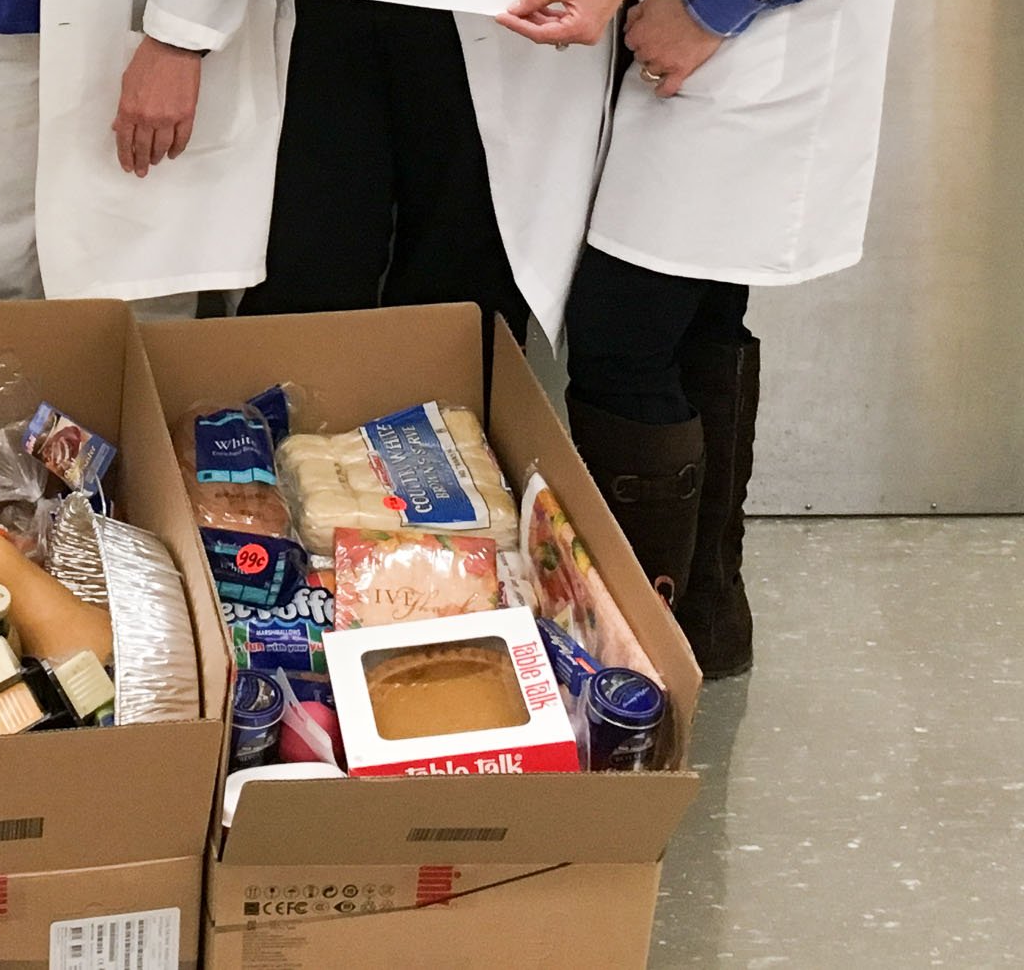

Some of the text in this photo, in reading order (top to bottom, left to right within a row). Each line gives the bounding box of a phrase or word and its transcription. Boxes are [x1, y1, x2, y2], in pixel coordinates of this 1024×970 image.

[266, 641, 288, 652] with
[287, 642, 308, 653] your
[511, 641, 547, 680] Table
[524, 679, 558, 711] Talk
[474, 753, 522, 775] Talk
